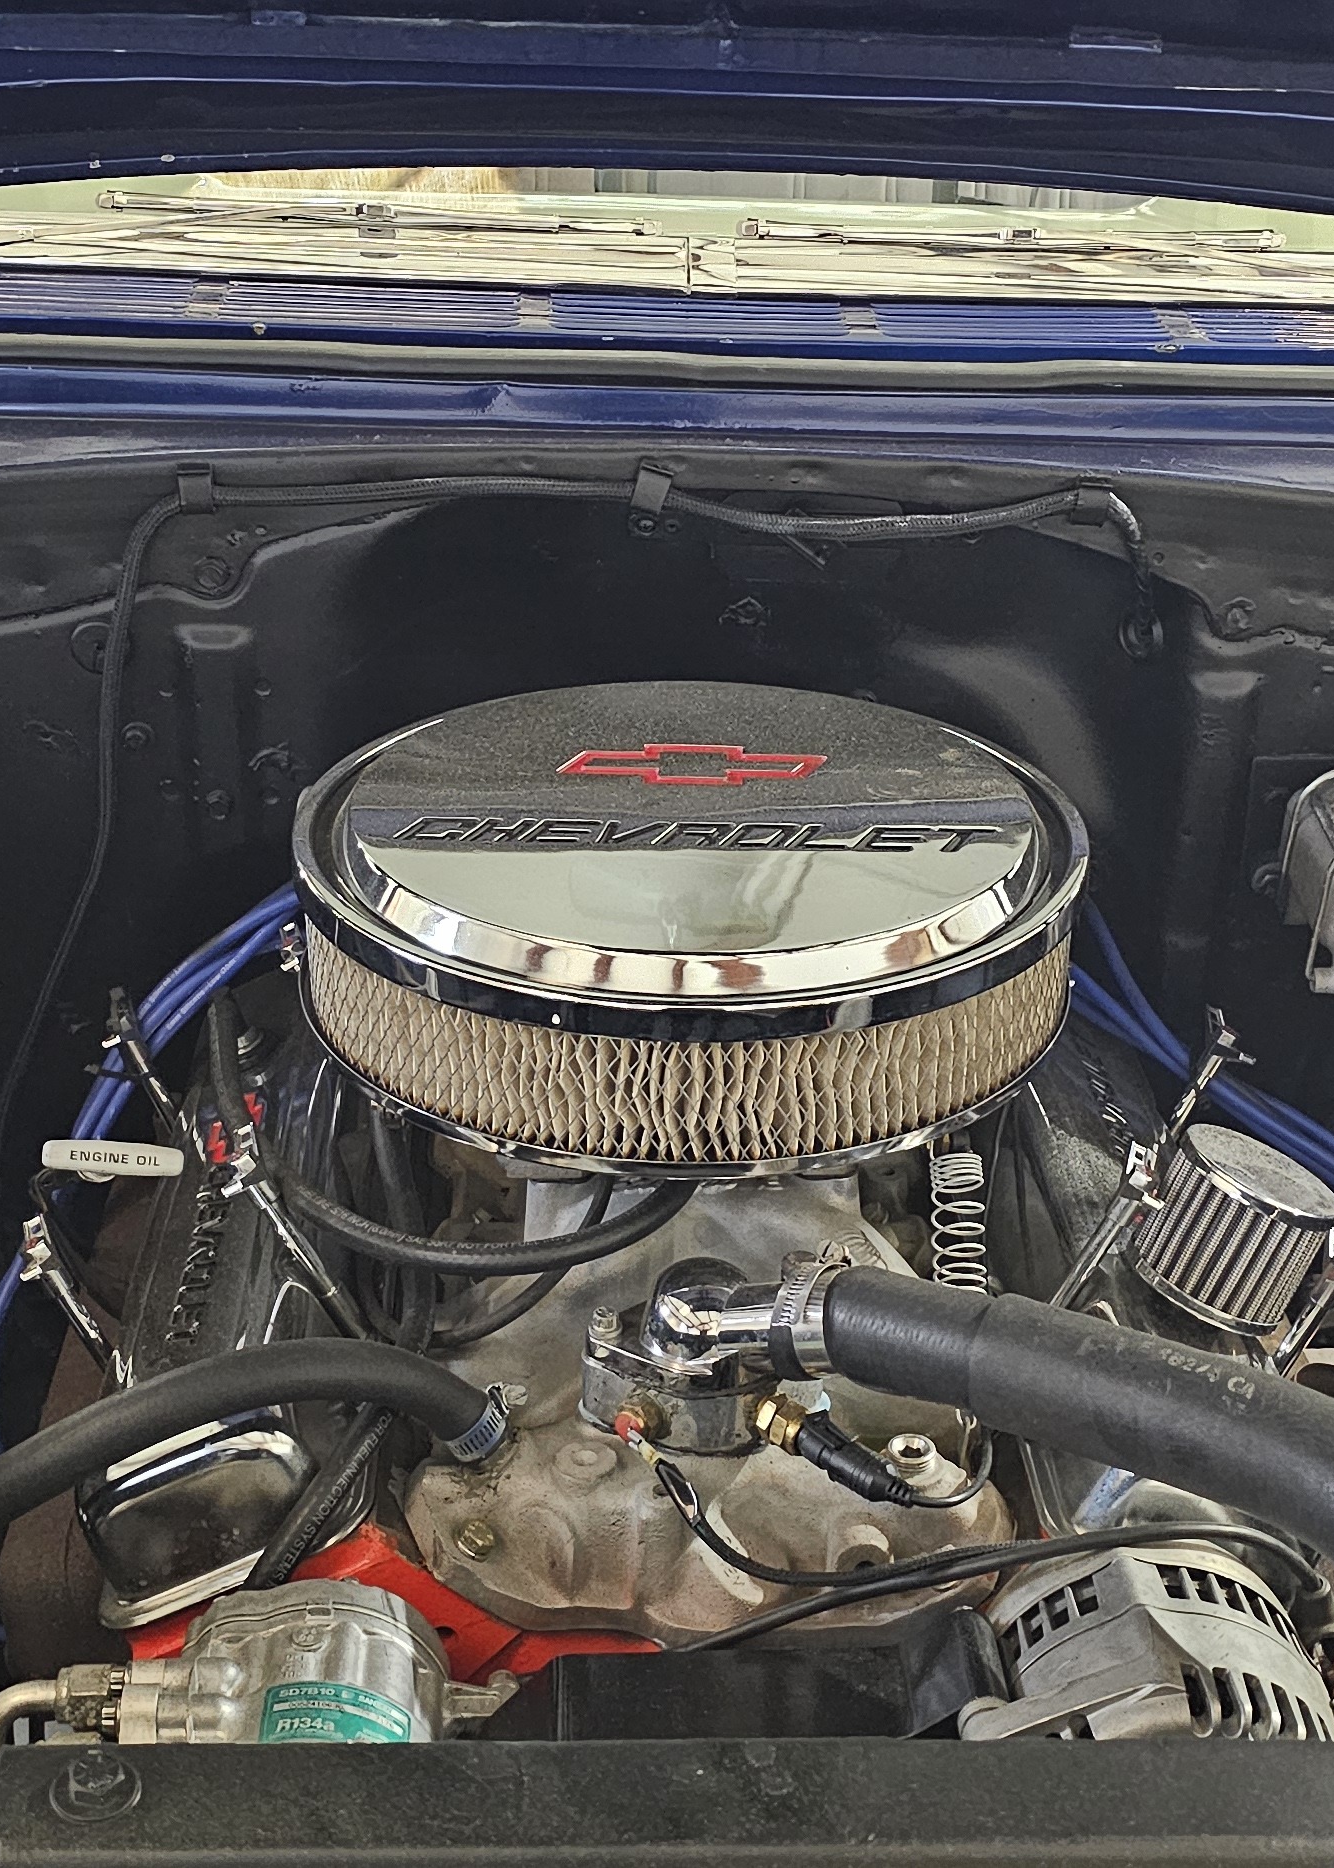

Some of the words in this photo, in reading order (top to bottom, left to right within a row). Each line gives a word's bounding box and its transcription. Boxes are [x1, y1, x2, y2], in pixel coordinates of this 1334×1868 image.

[392, 816, 1004, 853] CHEVROLET
[69, 1150, 129, 1165] ENGINE
[136, 1155, 161, 1167] OIL
[374, 1412, 393, 1438] FOR
[352, 1433, 379, 1463] FUEL
[313, 1458, 362, 1525] INJECTION
[276, 1525, 317, 1583] SYSTEMS
[274, 1717, 335, 1733] R134a
